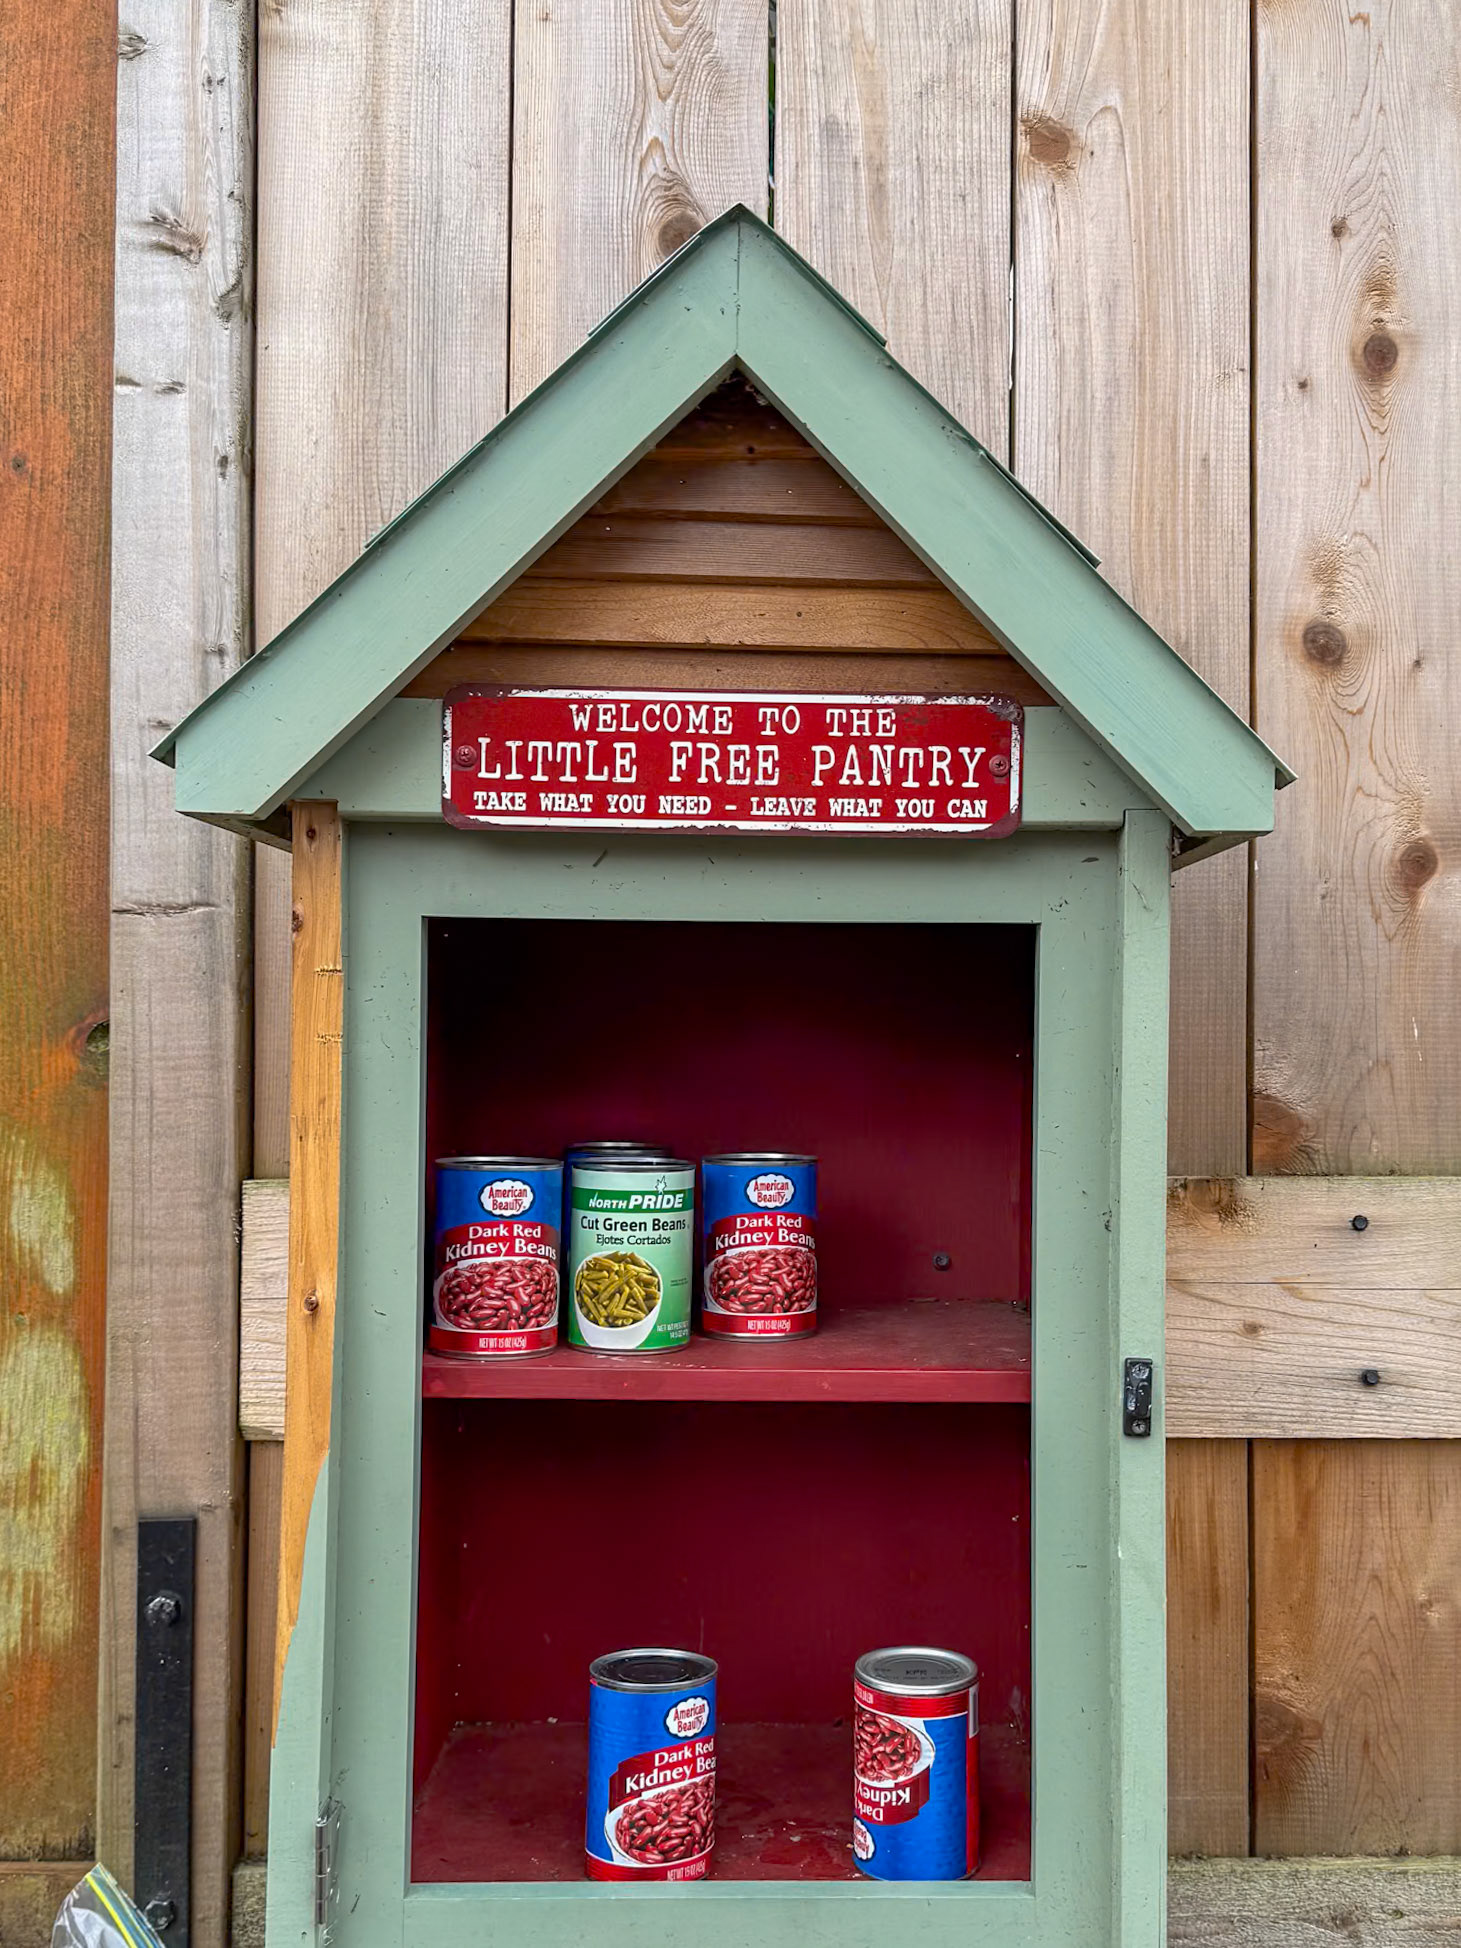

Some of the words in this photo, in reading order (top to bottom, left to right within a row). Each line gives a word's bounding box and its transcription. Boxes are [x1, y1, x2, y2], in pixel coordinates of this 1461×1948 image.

[568, 703, 733, 735] WELCOME
[758, 705, 801, 736] TO
[826, 708, 897, 737] THE
[477, 737, 637, 783] LITTLE
[668, 741, 780, 786] FREE
[811, 744, 986, 788] PANTRY
[473, 791, 527, 812] TAKE
[539, 793, 593, 813] WHAT
[607, 794, 646, 814] YOU
[659, 796, 711, 815] NEED
[750, 797, 816, 817] LEAVE
[829, 798, 882, 818] WHAT
[896, 799, 935, 818] YOU
[948, 799, 987, 819] CAN
[488, 1185, 528, 1199] American
[753, 1179, 789, 1192] American
[492, 1198, 524, 1212] Beauty
[589, 1192, 627, 1209] NORTH
[628, 1192, 684, 1210] PRIDE
[756, 1191, 786, 1204] Beauty
[581, 1216, 599, 1231] Cut
[603, 1217, 647, 1232] Green
[652, 1217, 686, 1231] Beans
[736, 1215, 773, 1229] Dark
[776, 1214, 802, 1228] Red
[469, 1224, 509, 1240] Dark
[513, 1223, 541, 1239] Red
[596, 1234, 624, 1246] Ejotes
[627, 1234, 671, 1246] Cortados
[715, 1230, 774, 1251] Kidney
[778, 1228, 816, 1249] Beans
[446, 1240, 510, 1263] Kidney
[514, 1238, 557, 1260] Beans
[673, 1703, 706, 1722] American
[654, 1745, 693, 1767] Dark
[695, 1738, 714, 1756] Red
[625, 1764, 693, 1794] Kidney
[857, 1781, 911, 1807] Kidney
[857, 1800, 884, 1821] Dark
